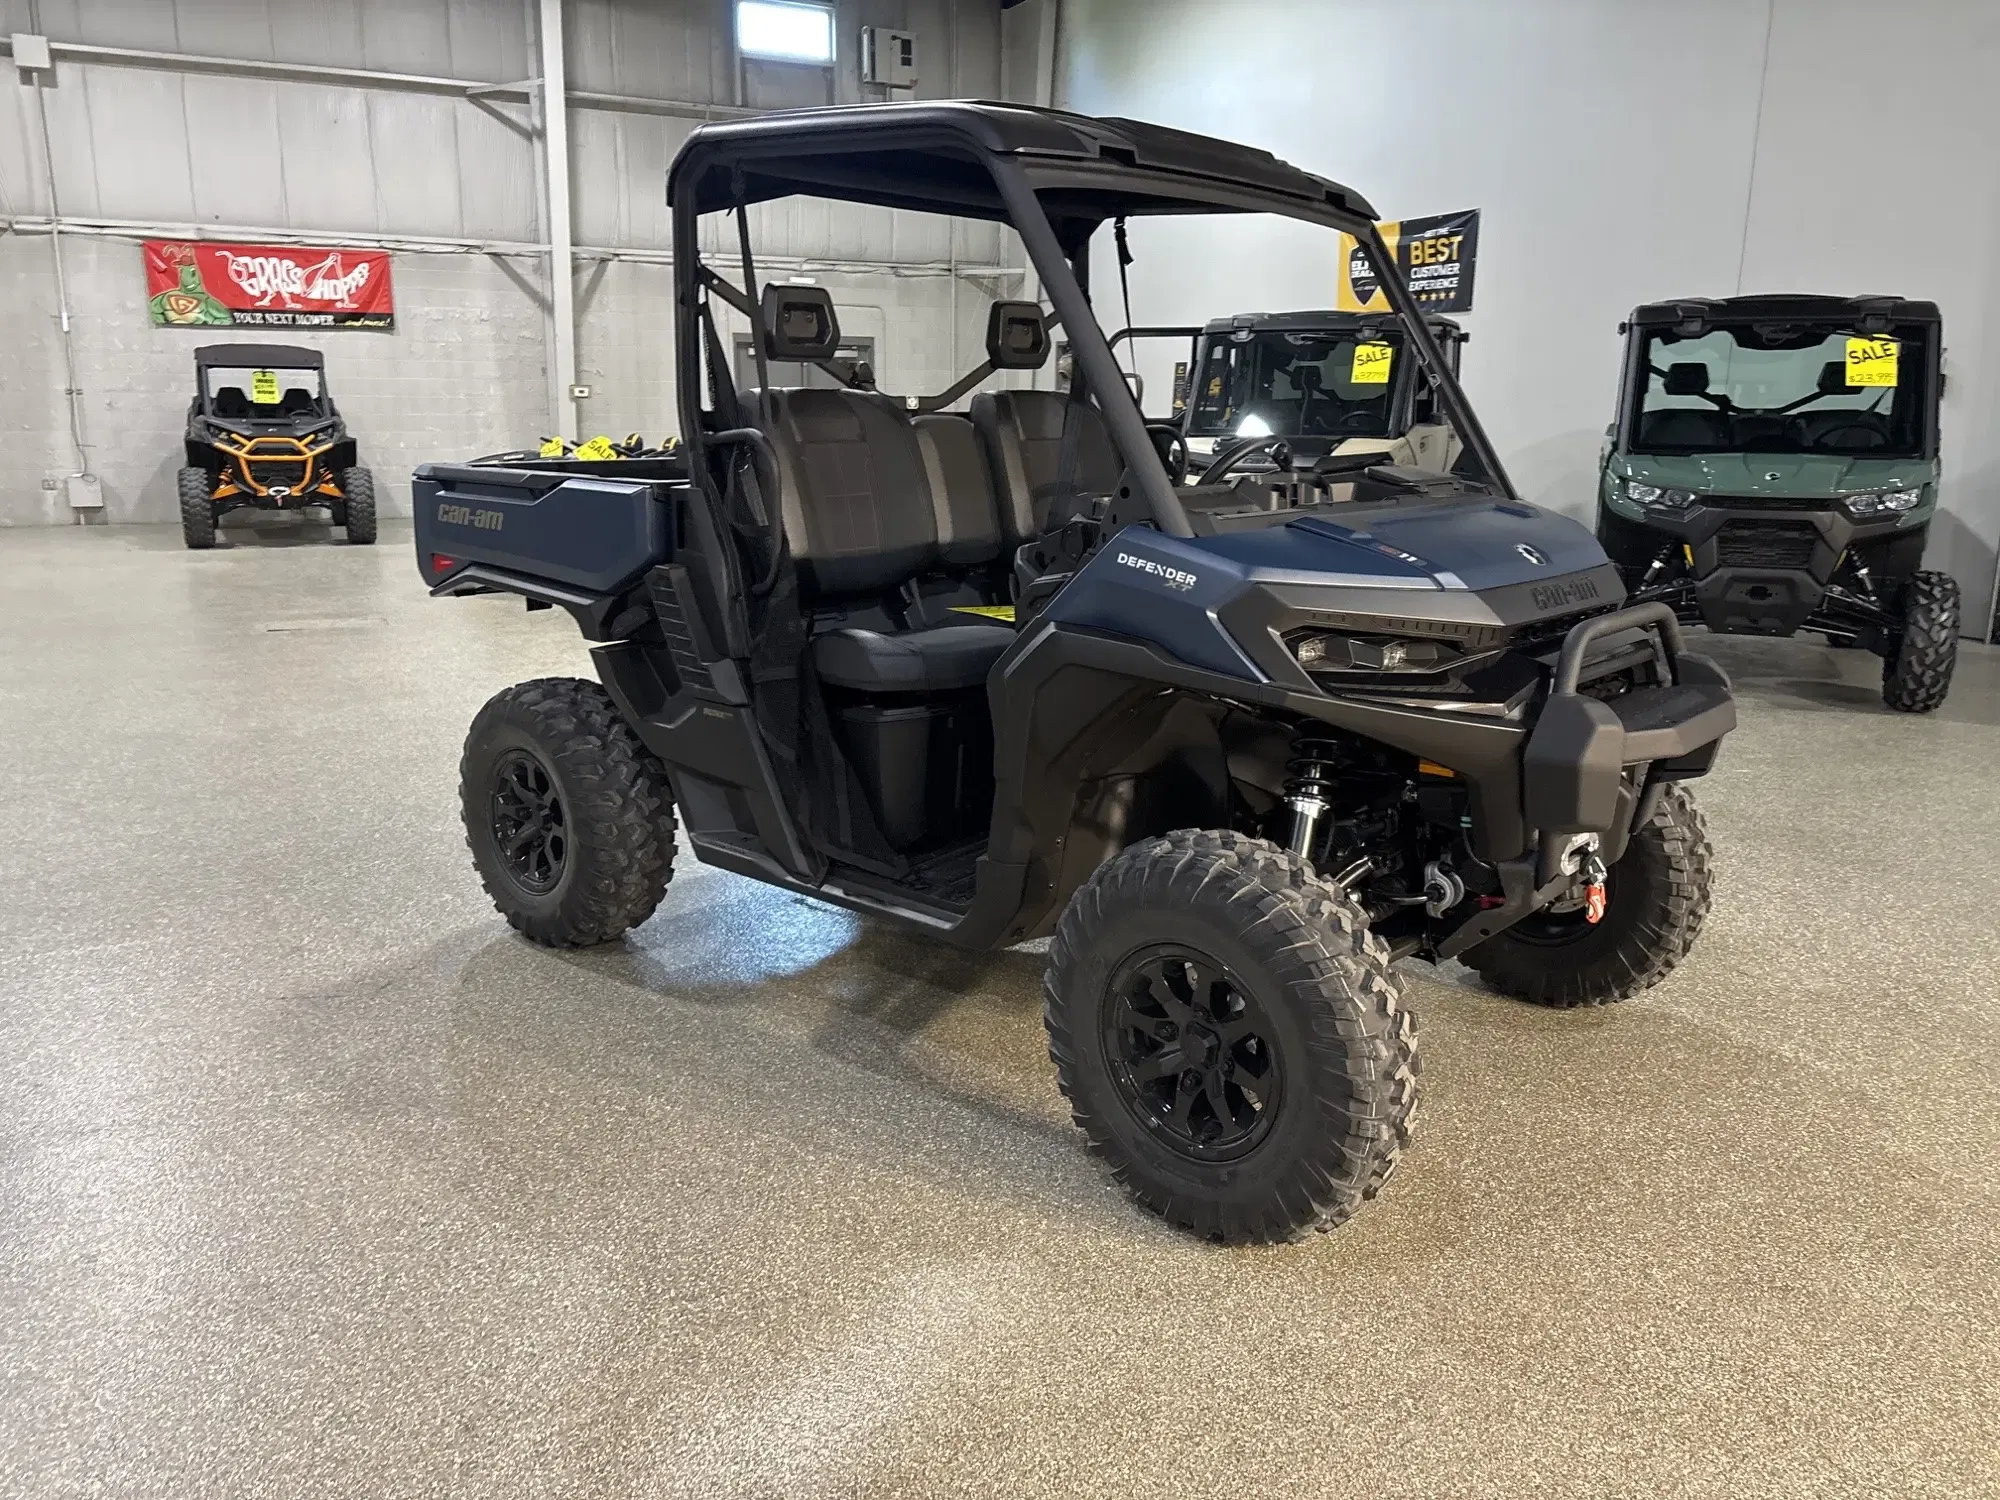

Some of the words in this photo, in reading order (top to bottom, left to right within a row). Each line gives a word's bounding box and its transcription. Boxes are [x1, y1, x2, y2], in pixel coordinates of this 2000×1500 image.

[1410, 235, 1464, 265] BEST
[1411, 263, 1461, 278] CUSTOMER
[1408, 277, 1460, 292] EXPERIENCE
[233, 312, 265, 324] YOUR
[265, 313, 294, 325] NEXT
[295, 314, 336, 326] MOWER
[1355, 347, 1389, 366] SALE
[1849, 342, 1896, 365] SALE
[1117, 552, 1197, 586] DEFENDER
[1164, 580, 1193, 592] XT
